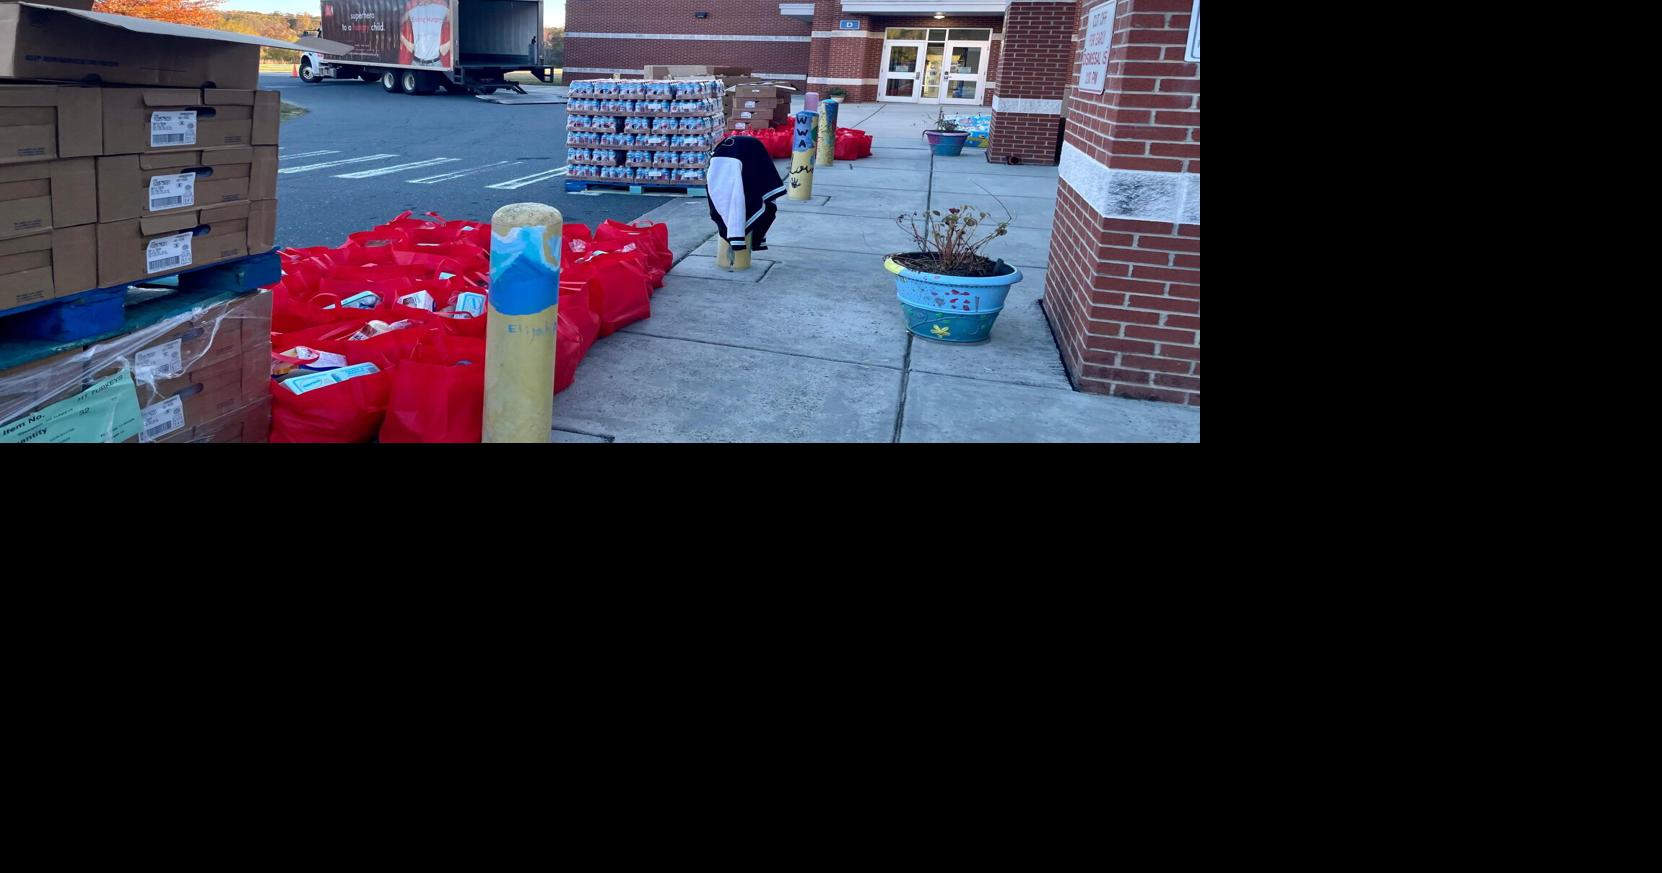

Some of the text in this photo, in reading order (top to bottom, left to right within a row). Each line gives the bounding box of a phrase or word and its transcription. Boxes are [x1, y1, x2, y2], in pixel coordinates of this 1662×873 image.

[350, 10, 375, 22] superhero
[341, 23, 347, 31] to
[2, 421, 26, 436] Item
[28, 414, 46, 423] No.
